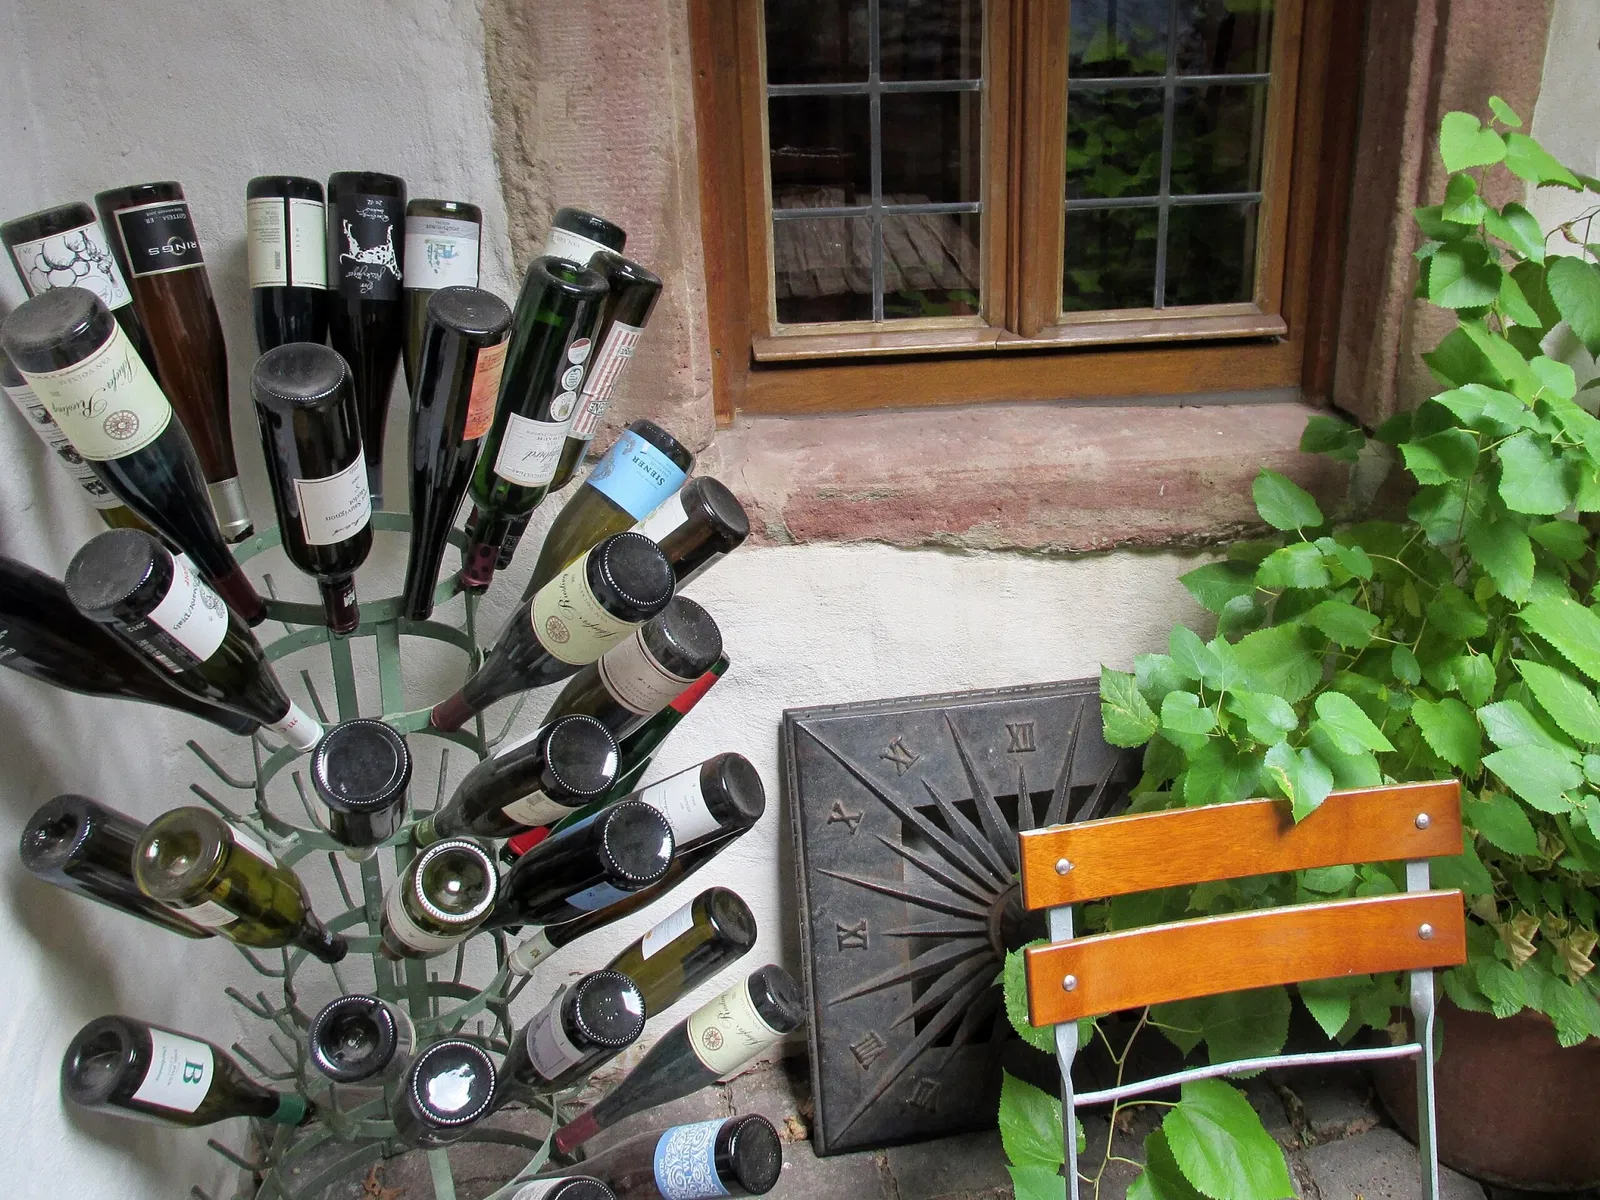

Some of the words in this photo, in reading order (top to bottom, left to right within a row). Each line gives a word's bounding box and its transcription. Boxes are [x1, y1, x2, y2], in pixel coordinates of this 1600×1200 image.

[148, 241, 196, 255] RINGS
[630, 455, 666, 486] SIENER
[324, 499, 361, 521] Sauvignon
[183, 1057, 203, 1084] B
